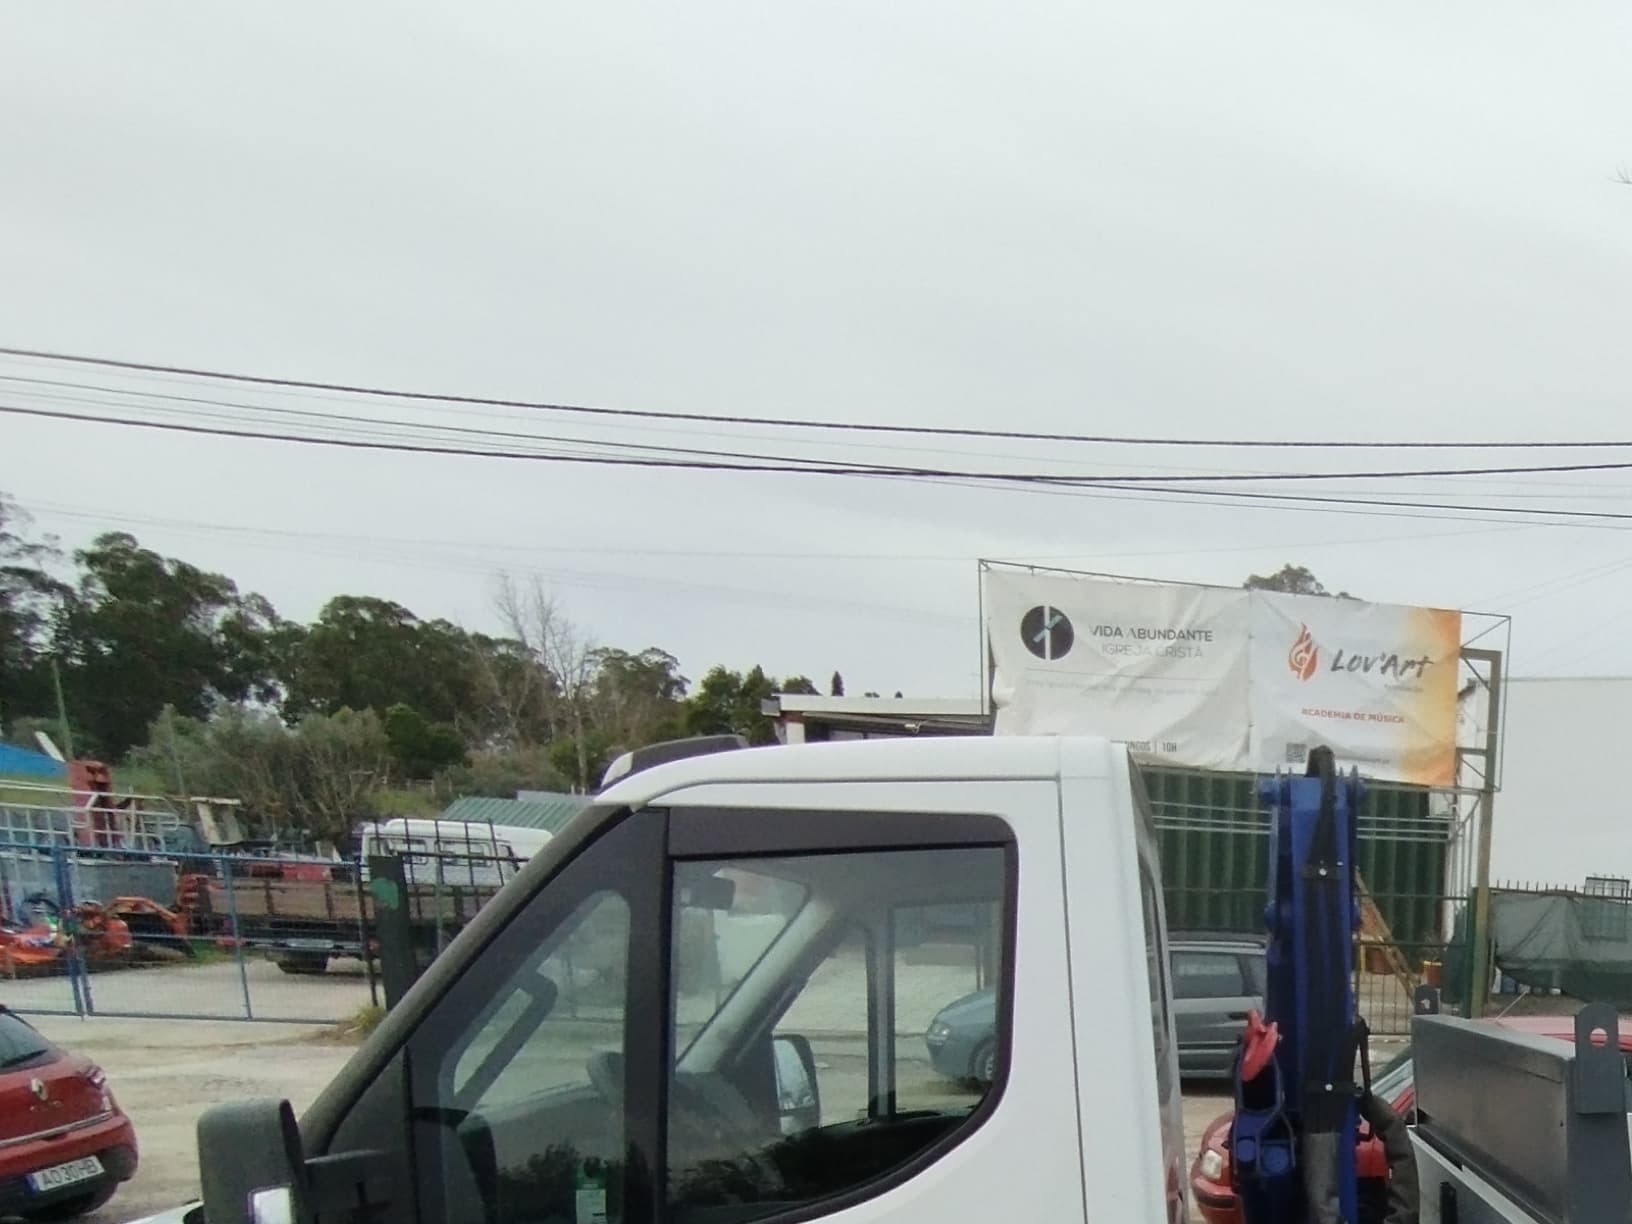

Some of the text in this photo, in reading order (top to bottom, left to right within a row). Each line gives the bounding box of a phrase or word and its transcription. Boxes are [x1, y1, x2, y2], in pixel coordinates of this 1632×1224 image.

[1089, 625, 1214, 642] VIDA ABUNDANTE
[1301, 707, 1352, 720] ACADEMIA
[1353, 711, 1367, 721] DE
